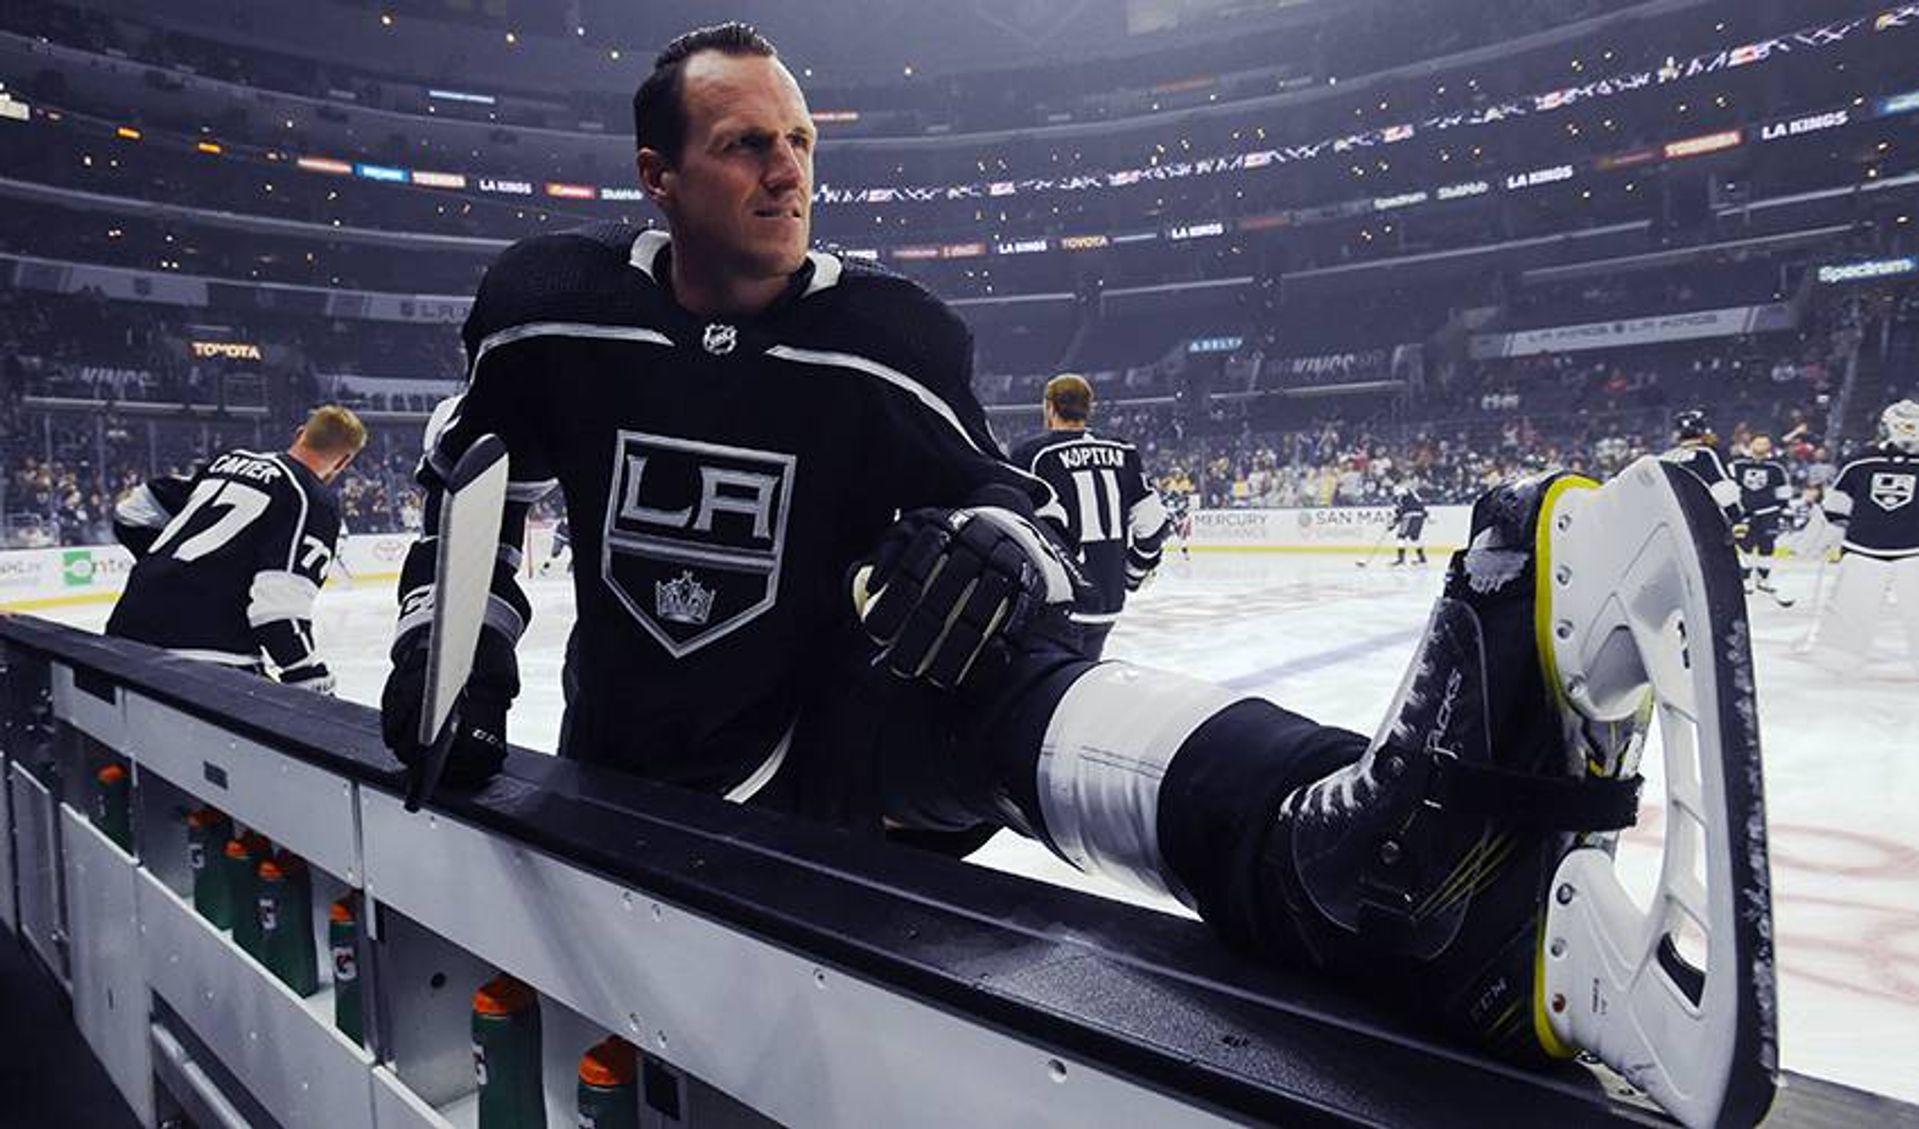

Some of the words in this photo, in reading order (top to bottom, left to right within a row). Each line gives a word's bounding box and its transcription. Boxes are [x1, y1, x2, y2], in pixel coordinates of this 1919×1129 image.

[1761, 123, 1788, 140] LA
[1789, 110, 1848, 135] KINGS
[1506, 173, 1528, 189] LA
[1529, 165, 1573, 185] KINGS
[479, 179, 496, 191] LA
[497, 181, 532, 194] KINGS
[1171, 226, 1188, 239] LA
[1188, 223, 1223, 238] KINGS
[998, 242, 1014, 254] LA
[1015, 239, 1048, 253] KINGS
[193, 342, 261, 360] TOYOTA
[620, 453, 780, 540] LA
[1071, 469, 1123, 543] 11
[1194, 512, 1267, 526] MERCURY
[1316, 511, 1352, 525] SAN
